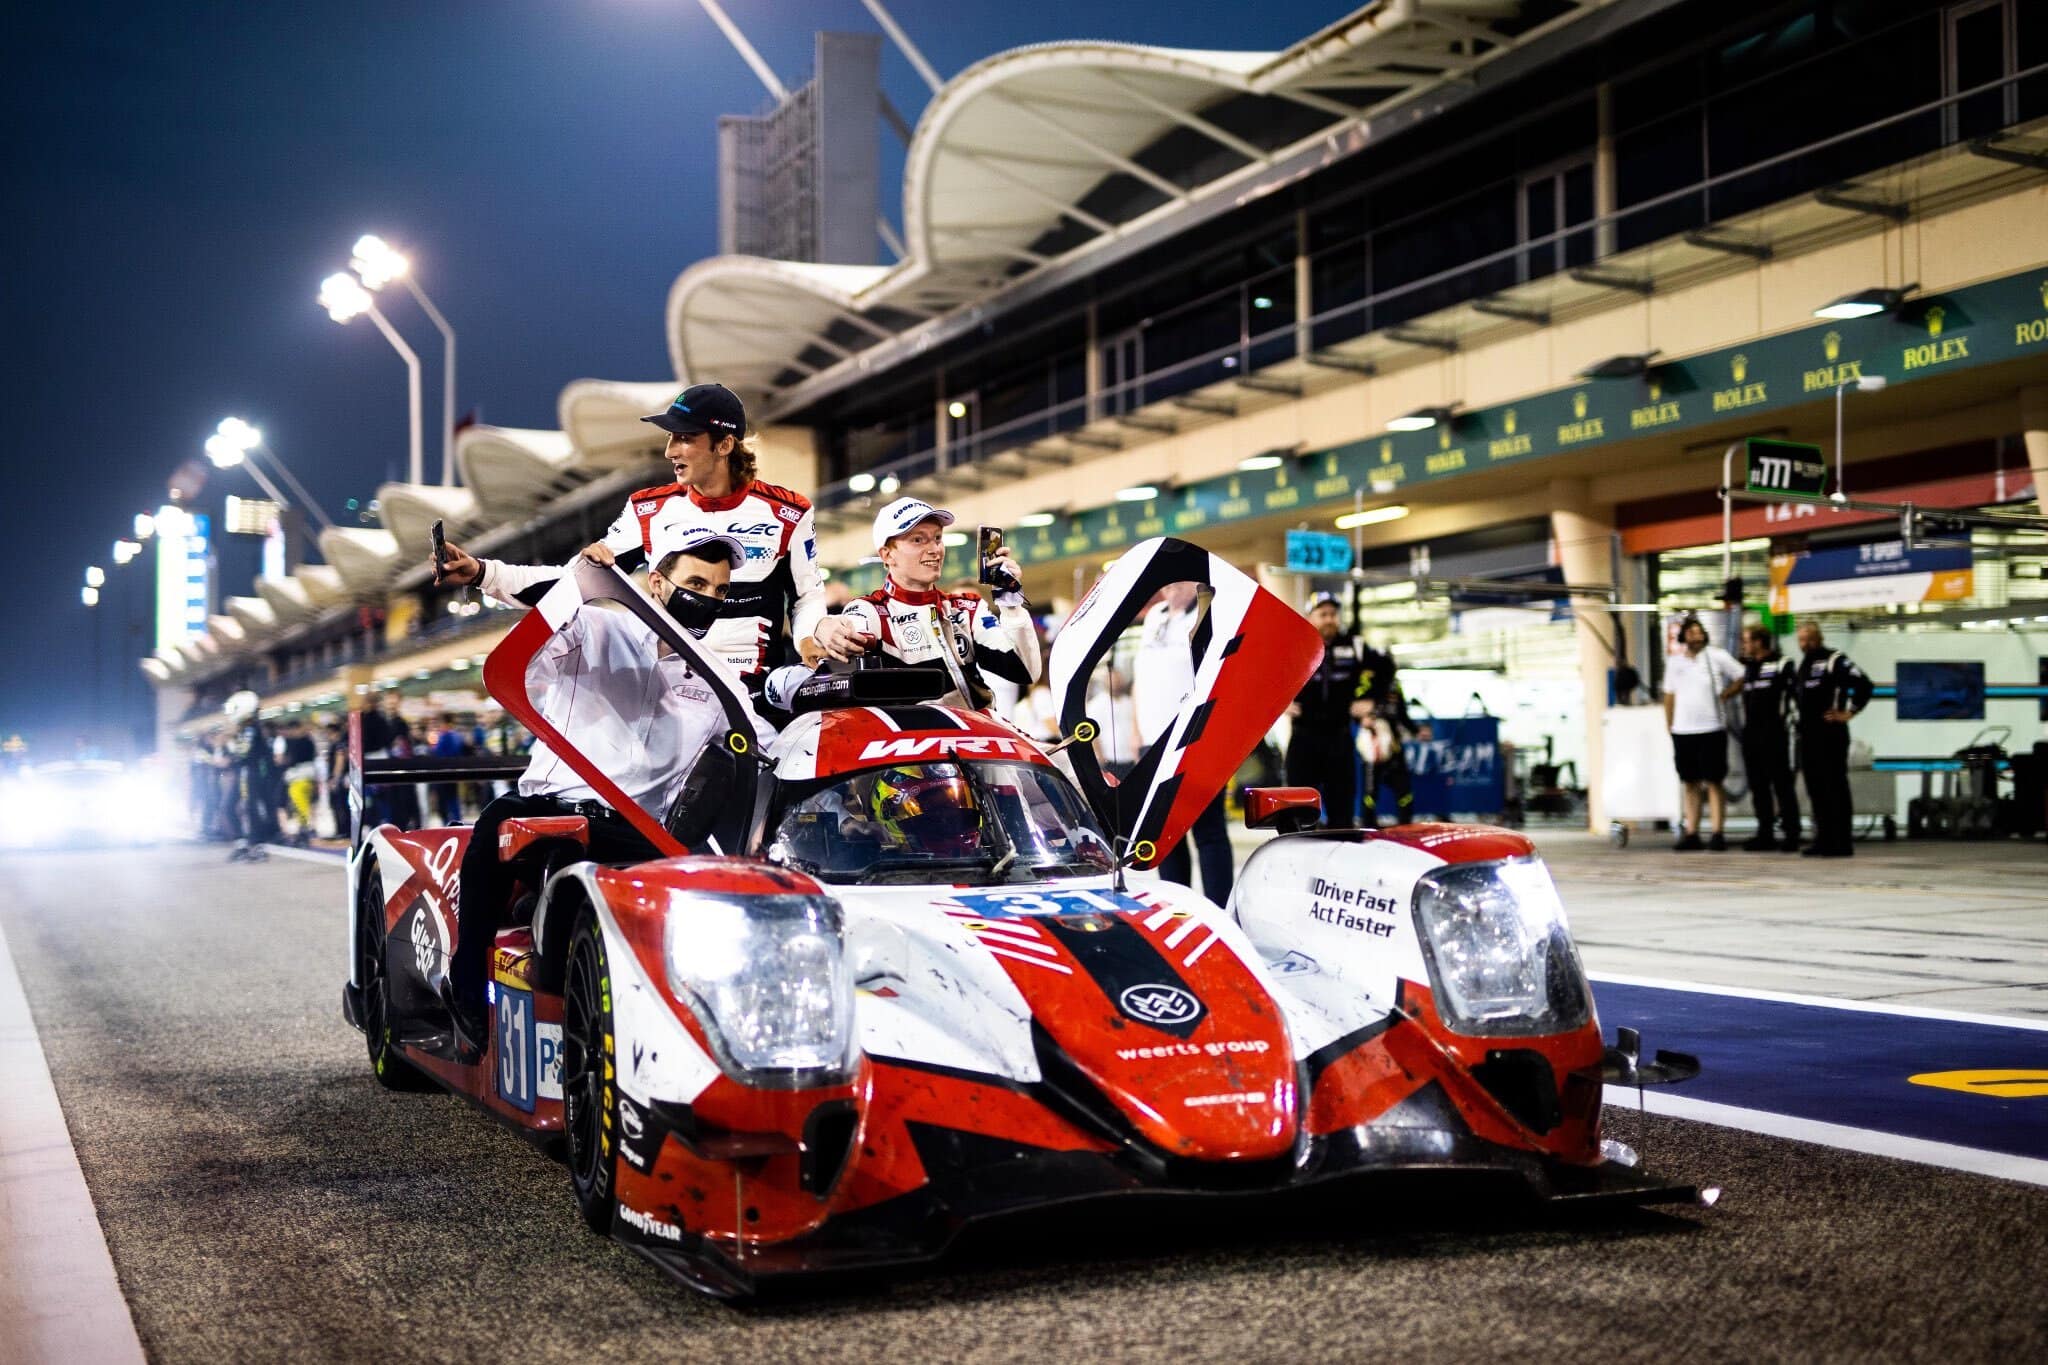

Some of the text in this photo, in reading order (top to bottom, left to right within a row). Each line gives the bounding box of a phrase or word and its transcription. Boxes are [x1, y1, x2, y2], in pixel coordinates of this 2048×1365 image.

[1903, 336, 1969, 370] ROLEX
[1803, 360, 1862, 392] ROLEX
[1712, 382, 1767, 412] ROLEX
[1631, 401, 1681, 430] ROLEX
[1557, 418, 1604, 446] ROLEX
[637, 502, 657, 515] OMP
[779, 507, 800, 523] OMP
[727, 522, 779, 536] WEC
[859, 736, 1018, 760] WRT
[986, 891, 1120, 915] 31
[1314, 878, 1398, 915] Drive Fast
[1309, 901, 1397, 938] Act Faster
[501, 994, 528, 1101] 31
[1116, 1040, 1270, 1061] weerts group
[620, 1203, 683, 1242] GOODYEAR
